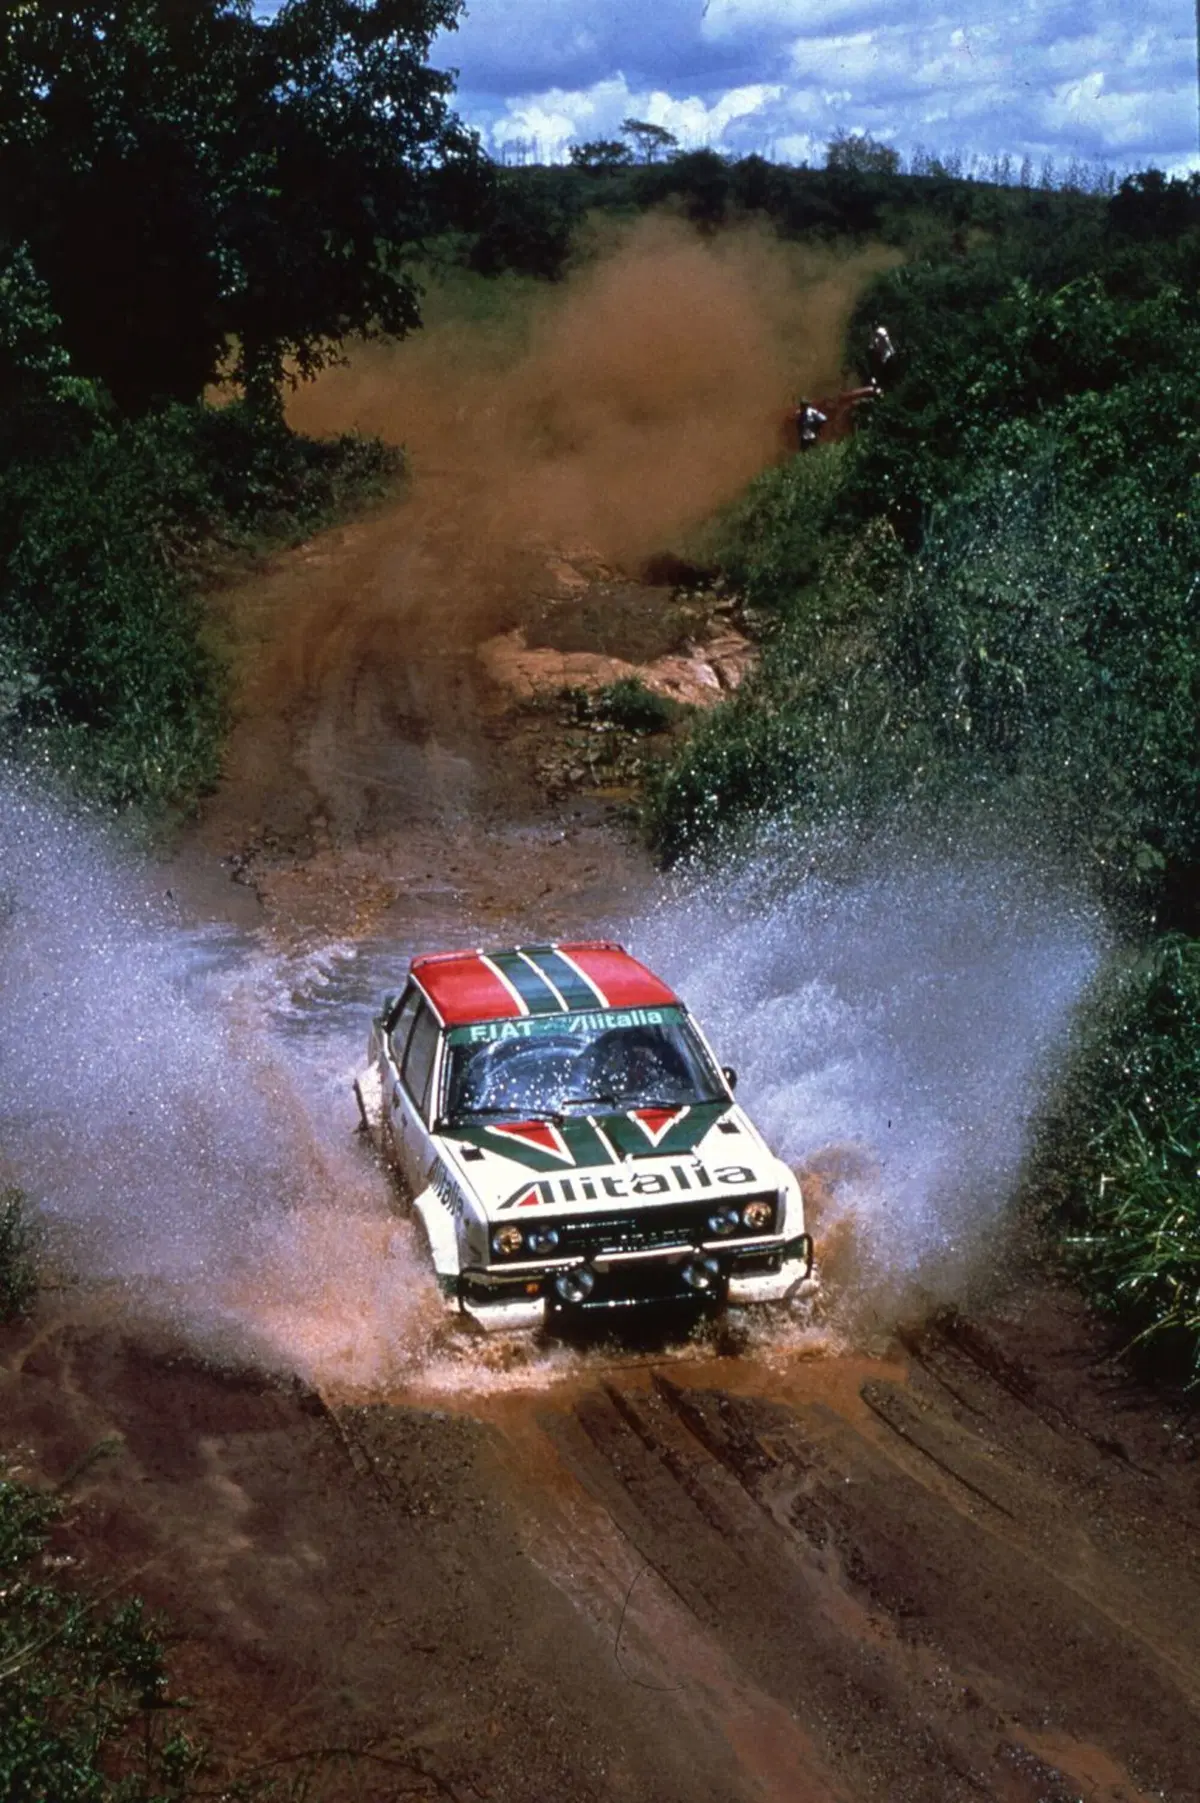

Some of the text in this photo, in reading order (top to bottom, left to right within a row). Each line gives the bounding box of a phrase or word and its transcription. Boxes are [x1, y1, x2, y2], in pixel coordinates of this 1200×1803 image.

[470, 1010, 663, 1041] FIAT Alitalia
[499, 1161, 757, 1209] Alitalia
